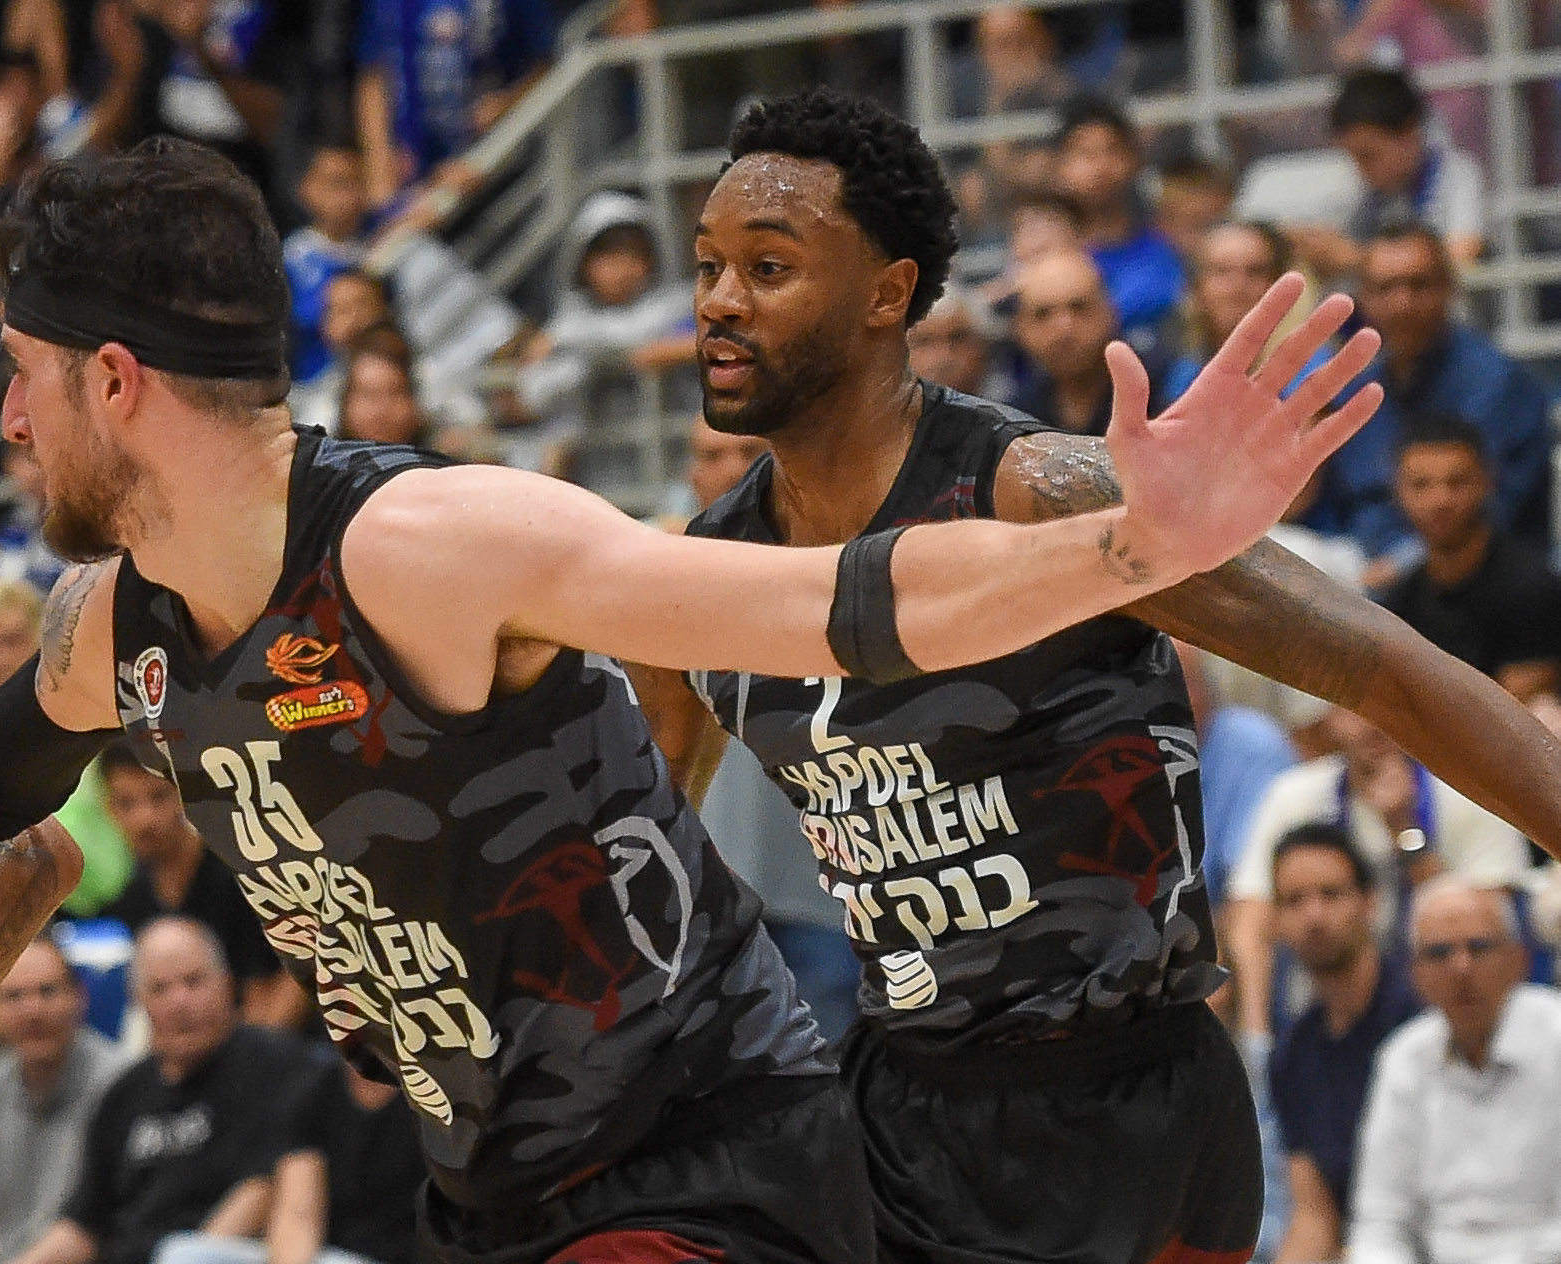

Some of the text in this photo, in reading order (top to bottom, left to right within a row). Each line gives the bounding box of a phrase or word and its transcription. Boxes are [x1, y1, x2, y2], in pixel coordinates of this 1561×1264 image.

[280, 700, 349, 723] Winner
[804, 676, 856, 754] 2
[200, 740, 325, 862] 35
[884, 853, 1040, 951] בנק
